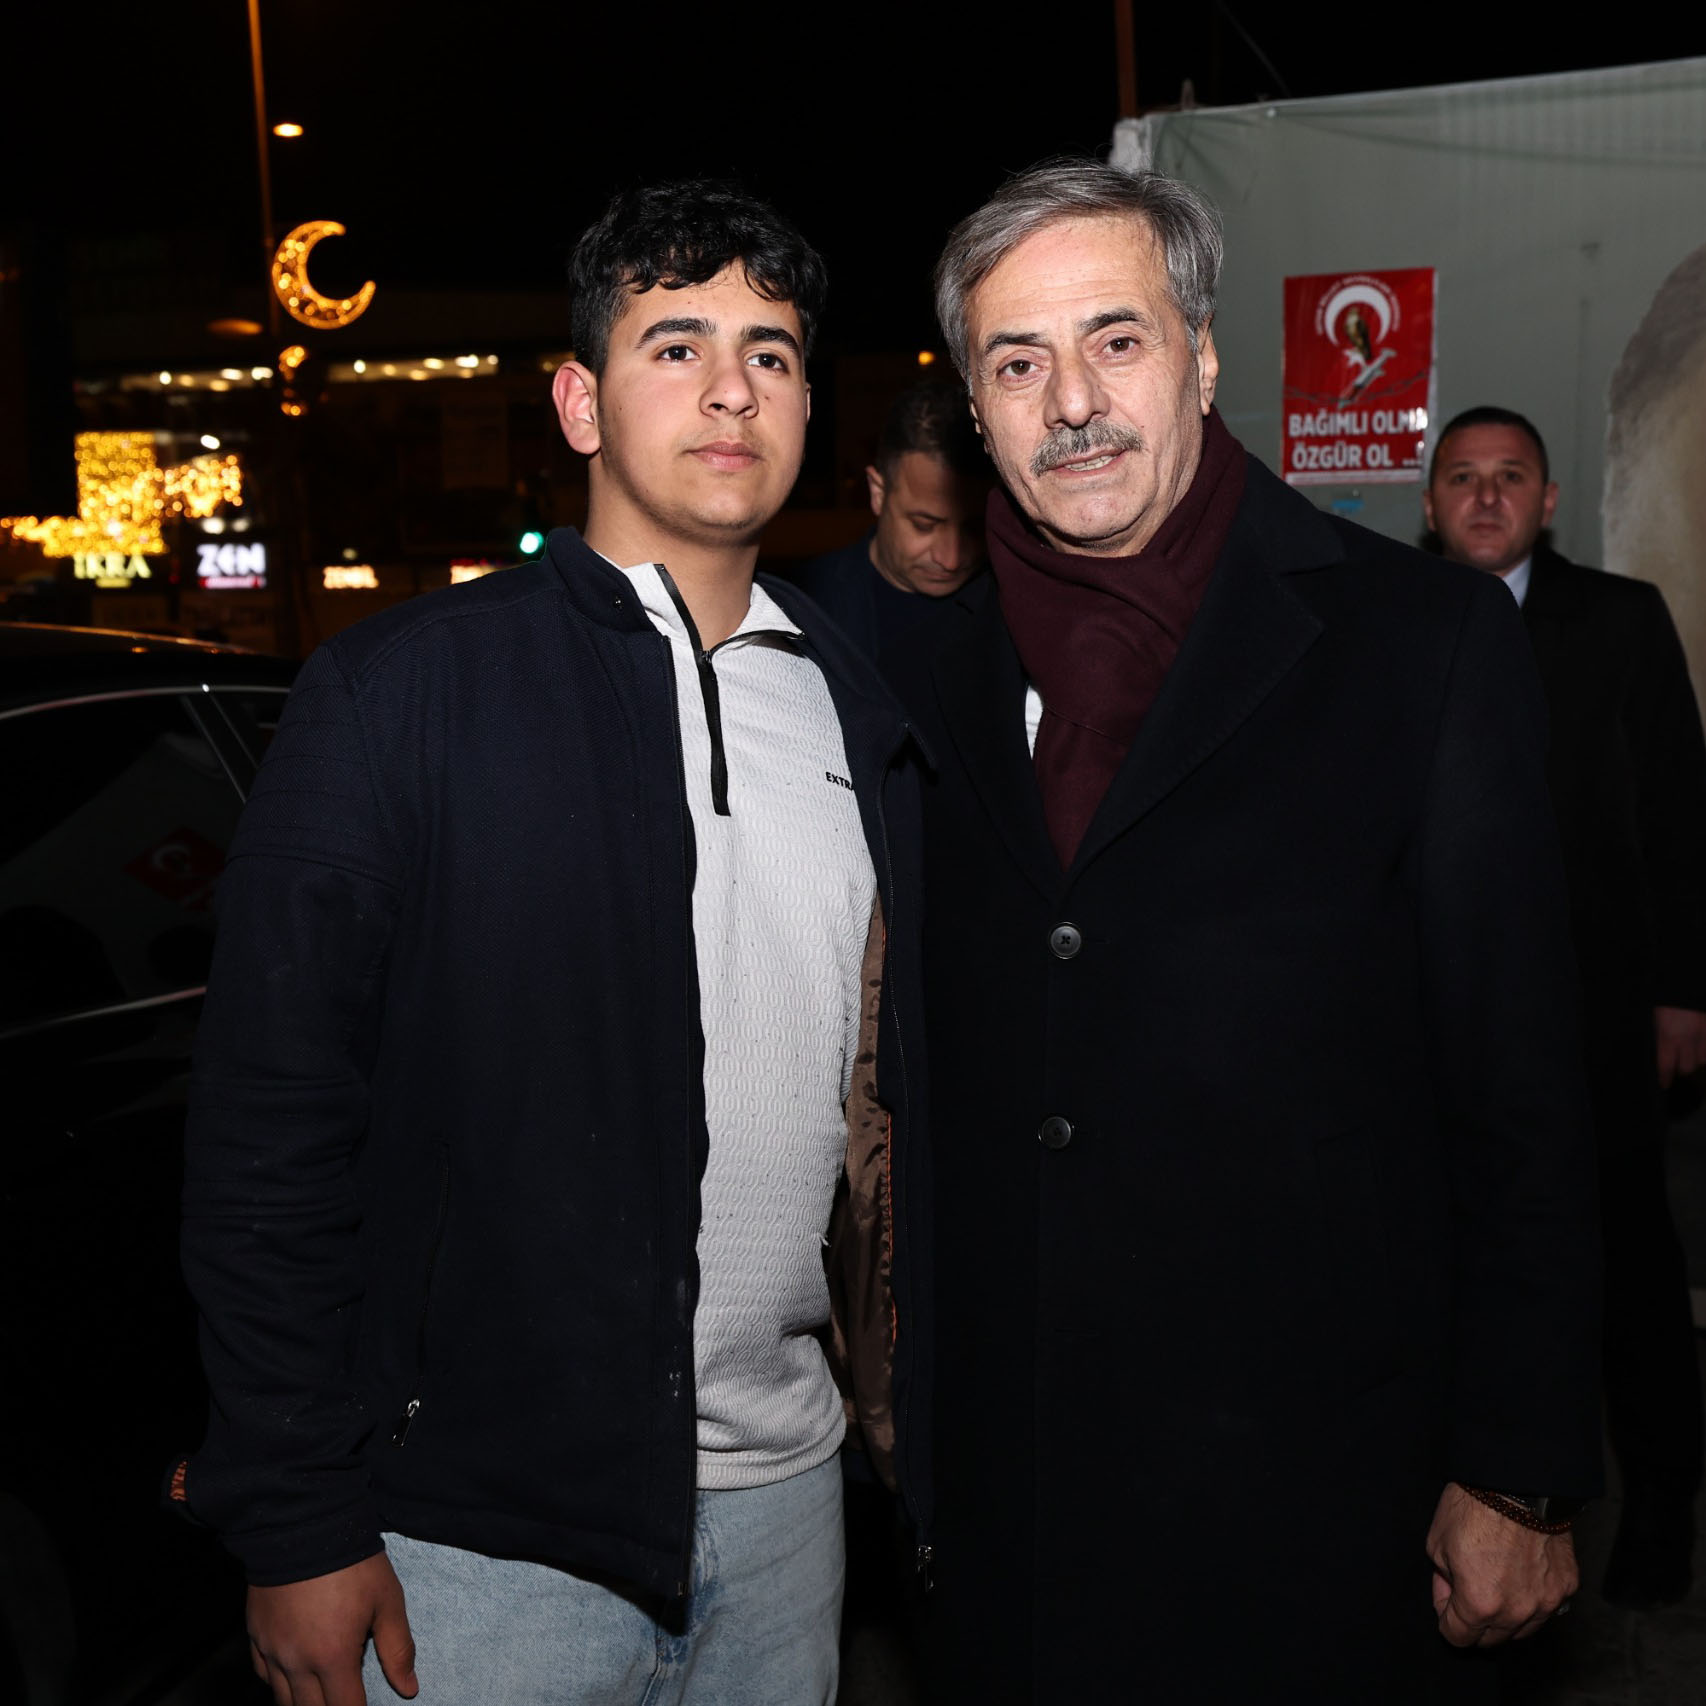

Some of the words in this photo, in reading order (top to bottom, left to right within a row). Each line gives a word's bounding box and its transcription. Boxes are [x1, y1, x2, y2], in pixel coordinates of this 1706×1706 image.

[1289, 409, 1368, 437] BAĞIMLI
[1292, 440, 1362, 469] ÖZGÜR
[1366, 445, 1394, 467] OL
